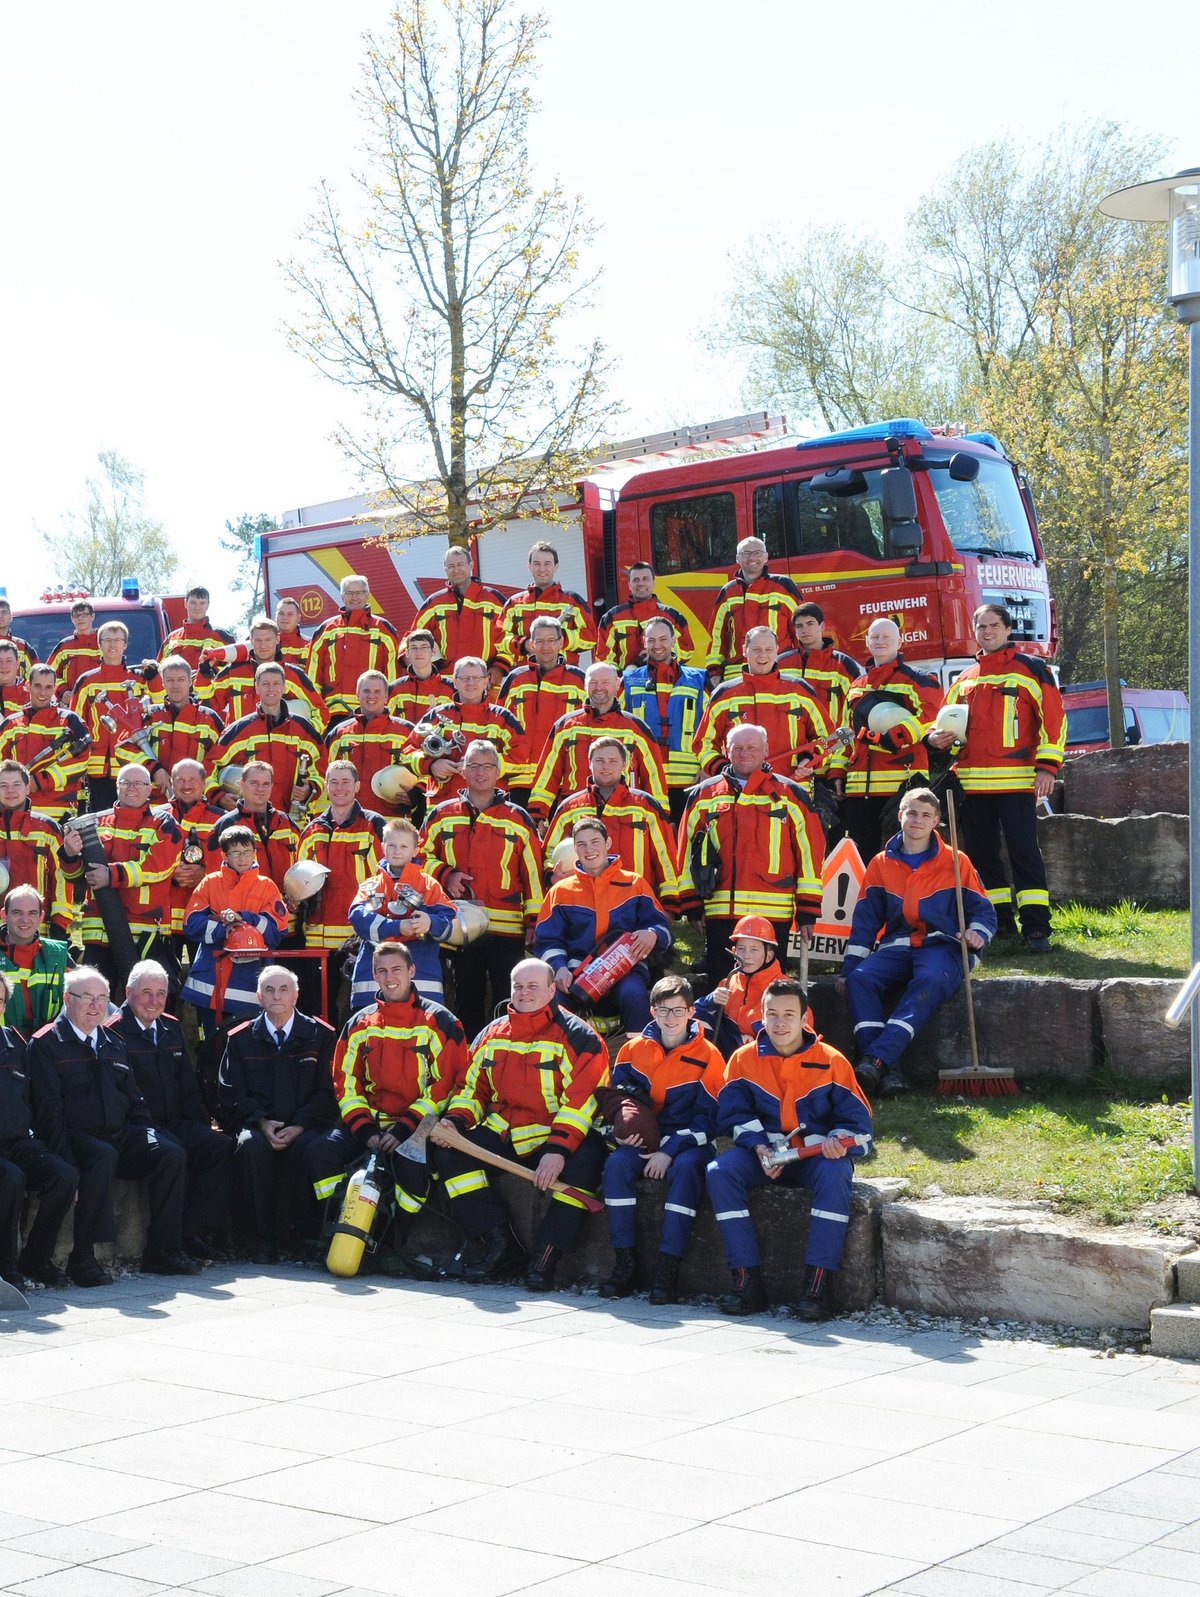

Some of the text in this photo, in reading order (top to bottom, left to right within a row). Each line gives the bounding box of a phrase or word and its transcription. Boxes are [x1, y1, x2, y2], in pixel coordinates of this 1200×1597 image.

[976, 564, 1044, 590] FEUERWEHR
[302, 597, 321, 612] 112
[859, 596, 928, 615] FEUERWEHR
[1007, 606, 1032, 620] MAN
